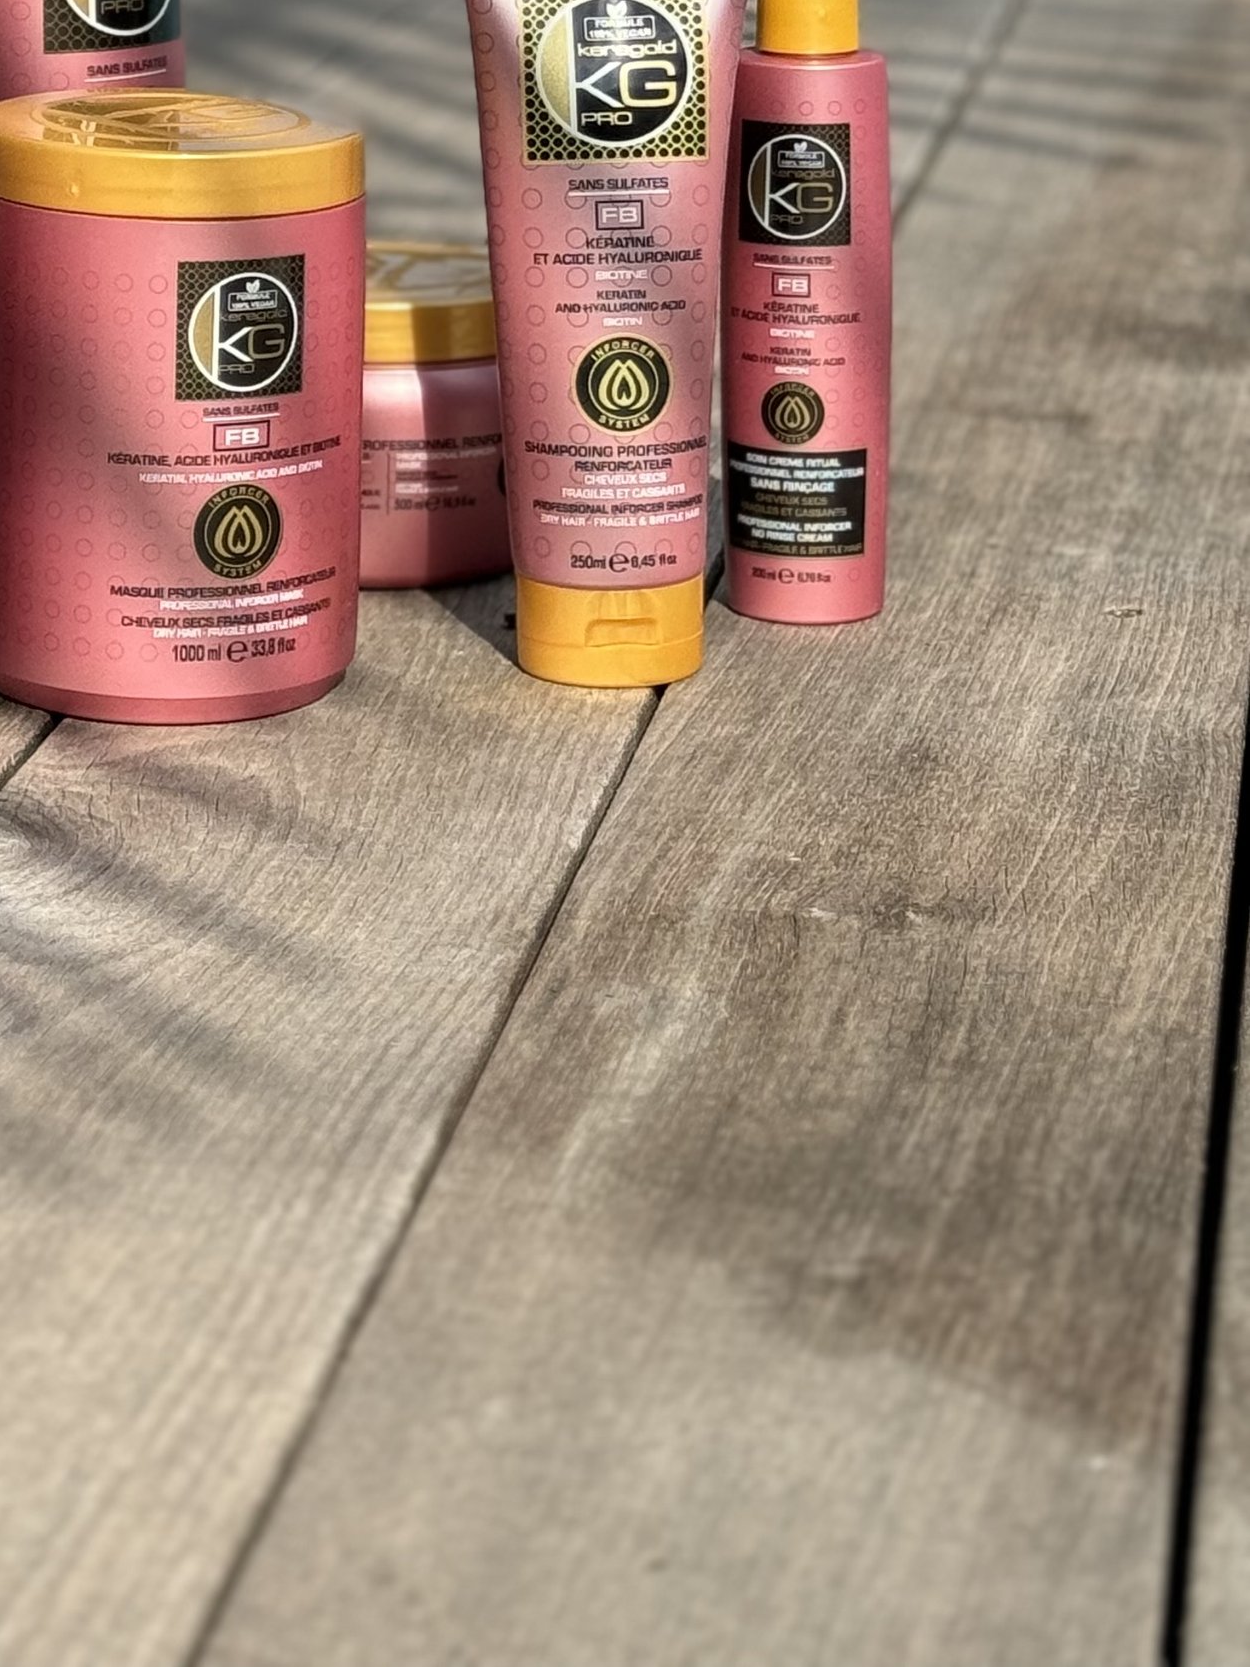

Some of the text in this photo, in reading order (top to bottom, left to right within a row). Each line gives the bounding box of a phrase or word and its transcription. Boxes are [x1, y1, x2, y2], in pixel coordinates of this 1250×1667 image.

[577, 39, 677, 59] keragold
[86, 63, 120, 77] SANS
[581, 111, 633, 126] PRO
[568, 177, 669, 191] SANS SULFATES
[602, 207, 638, 223] FB
[586, 235, 655, 249] KÉRATINE
[533, 248, 703, 265] ET ACIDE HYALURONIQUE
[595, 269, 648, 281] BIOTINE
[779, 278, 809, 293] FB
[597, 289, 647, 301] KERATIN
[555, 300, 687, 314] AND HYALURONIC ACID
[763, 300, 820, 314] KÉRATINE
[603, 316, 643, 327] BIOTIN
[772, 312, 862, 326] HYALURONIQUE
[591, 340, 656, 362] INFORCER
[770, 346, 811, 357] KERATIN
[598, 413, 651, 430] SYSTEM
[225, 427, 261, 446] FB
[174, 455, 212, 466] ACIDE
[213, 445, 300, 465] HYALURONIQUE
[524, 440, 613, 458] SHAMPOOING
[574, 458, 672, 472] RENFORCATEUR
[746, 452, 768, 465] SOIN
[584, 472, 667, 485] CHEVEUX SECS
[793, 467, 864, 480] RENFORCATEUR
[561, 483, 686, 500] FRAGILES ET CASSANTS
[750, 477, 835, 495] SANS RINÇAGE
[208, 485, 271, 508] INFORCER
[801, 495, 829, 505] SECS
[533, 499, 609, 515] PROFESSIONAL
[610, 502, 665, 515] INFORCER
[781, 505, 793, 516] ET
[561, 515, 587, 526] HAIR
[593, 517, 637, 527] FRAGILE
[738, 514, 853, 532] PROFESSIONAL INFORCER
[751, 528, 833, 543] NO RINSE CREAM
[213, 559, 263, 577] SYSTEM
[167, 583, 265, 599] PROFESSIONNEL
[121, 615, 181, 628] CHEVEUX
[182, 616, 216, 628] SECS
[217, 611, 270, 627] FRAGILES
[271, 609, 284, 622] ET
[172, 644, 205, 662] 1000
[207, 643, 222, 662] ml
[251, 637, 275, 658] 33,8
